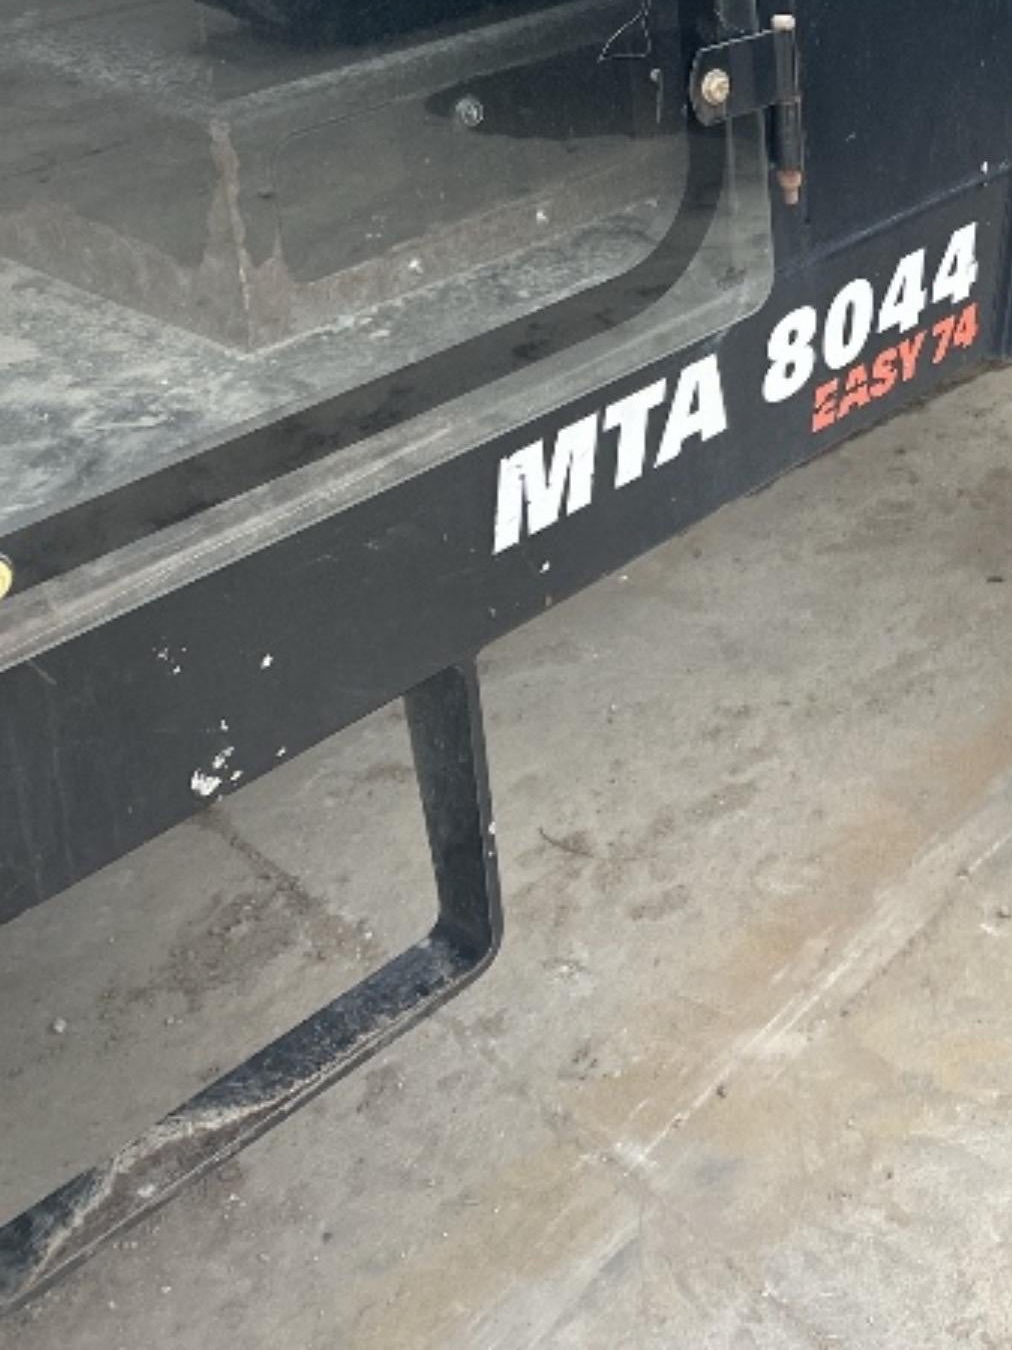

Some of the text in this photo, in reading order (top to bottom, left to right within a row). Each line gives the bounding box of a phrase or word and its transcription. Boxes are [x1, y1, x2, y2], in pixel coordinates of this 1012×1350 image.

[493, 222, 978, 555] MTA 8044
[811, 302, 979, 433] EASY 74
